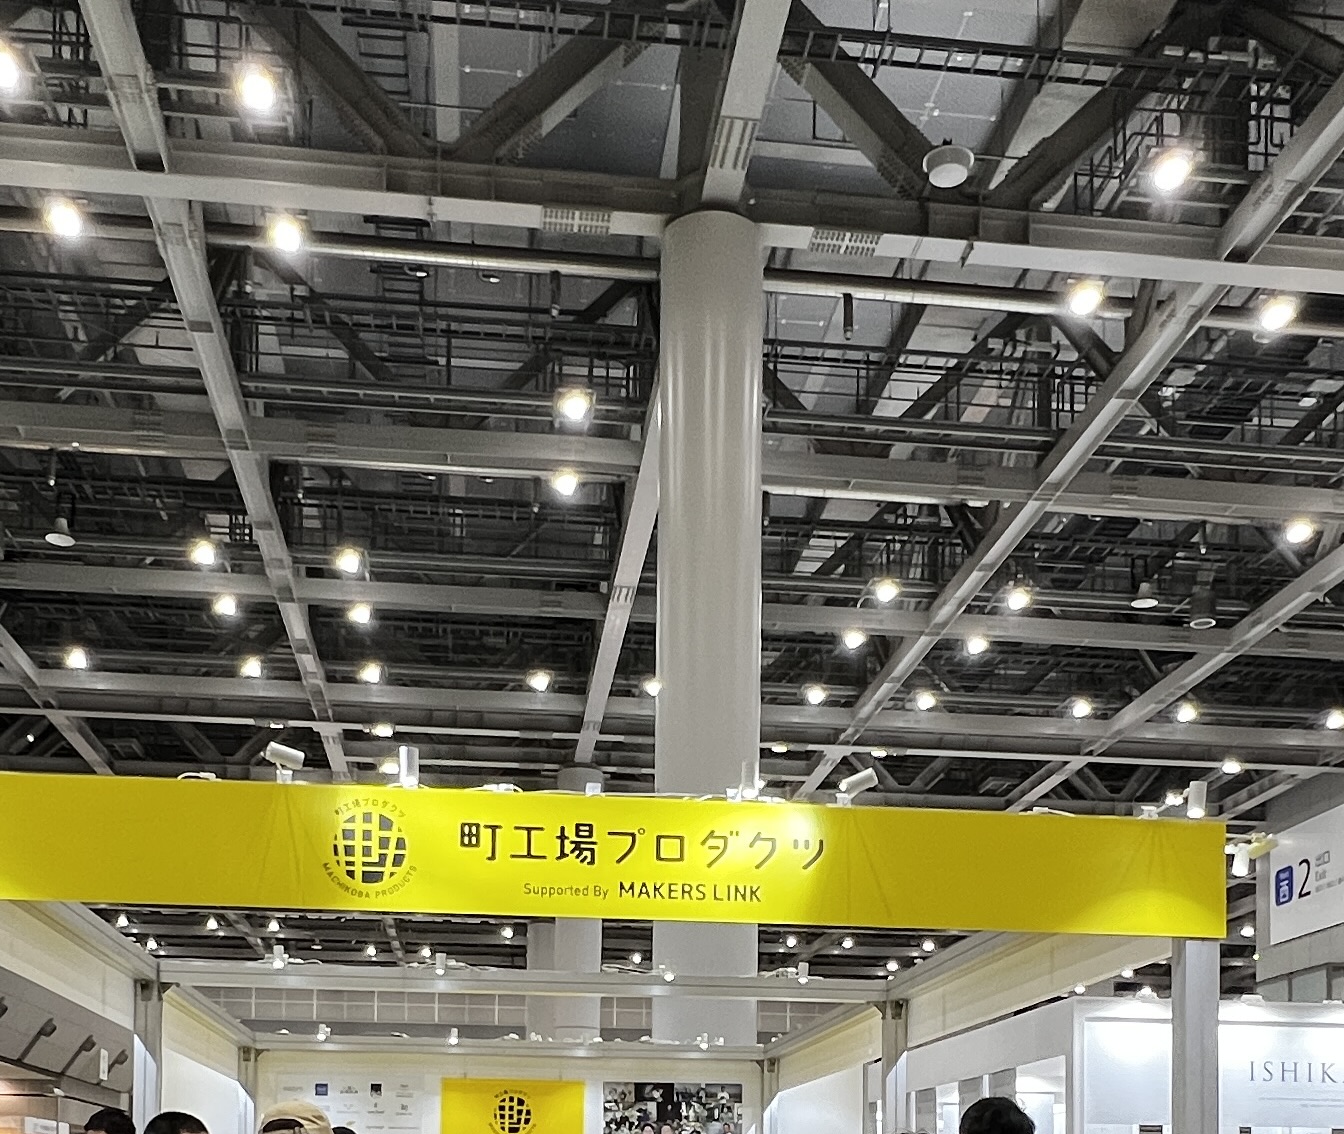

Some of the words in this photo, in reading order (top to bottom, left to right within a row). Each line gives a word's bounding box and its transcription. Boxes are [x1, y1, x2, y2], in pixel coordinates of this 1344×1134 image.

[459, 822, 825, 870] 町工場プロダクツ
[322, 862, 370, 899] MACHIKOBA
[375, 864, 418, 899] PRODUCTS
[523, 882, 589, 899] Supported
[593, 885, 609, 900] By
[619, 881, 706, 901] MAKERS
[713, 884, 762, 903] LINK
[1298, 858, 1311, 899] 2
